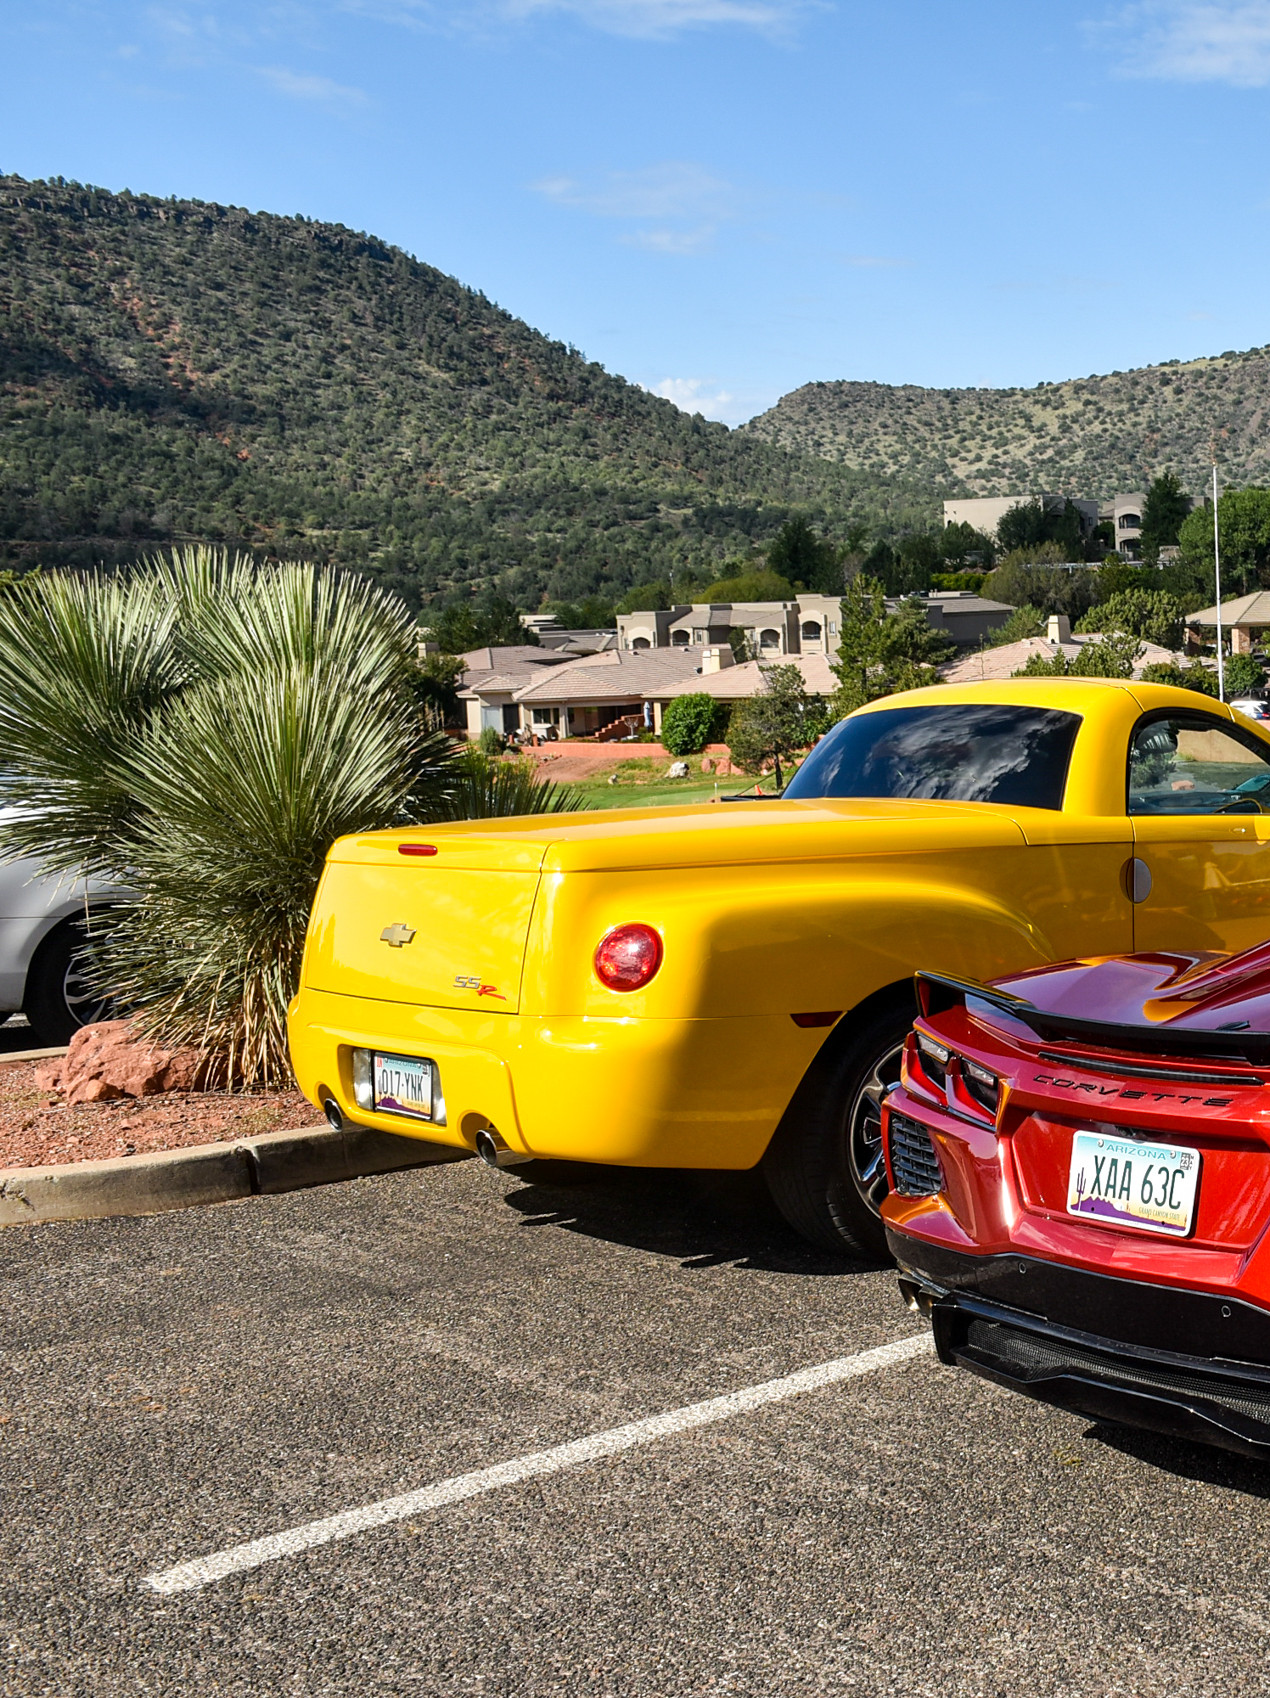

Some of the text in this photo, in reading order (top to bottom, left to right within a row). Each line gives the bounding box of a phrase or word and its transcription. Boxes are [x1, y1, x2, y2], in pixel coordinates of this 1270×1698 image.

[1033, 1074, 1234, 1107] CORVETTE
[1106, 1143, 1166, 1160] ARIZONA
[1090, 1155, 1185, 1210] XAA 63C
[1138, 1207, 1152, 1216] GRAND
